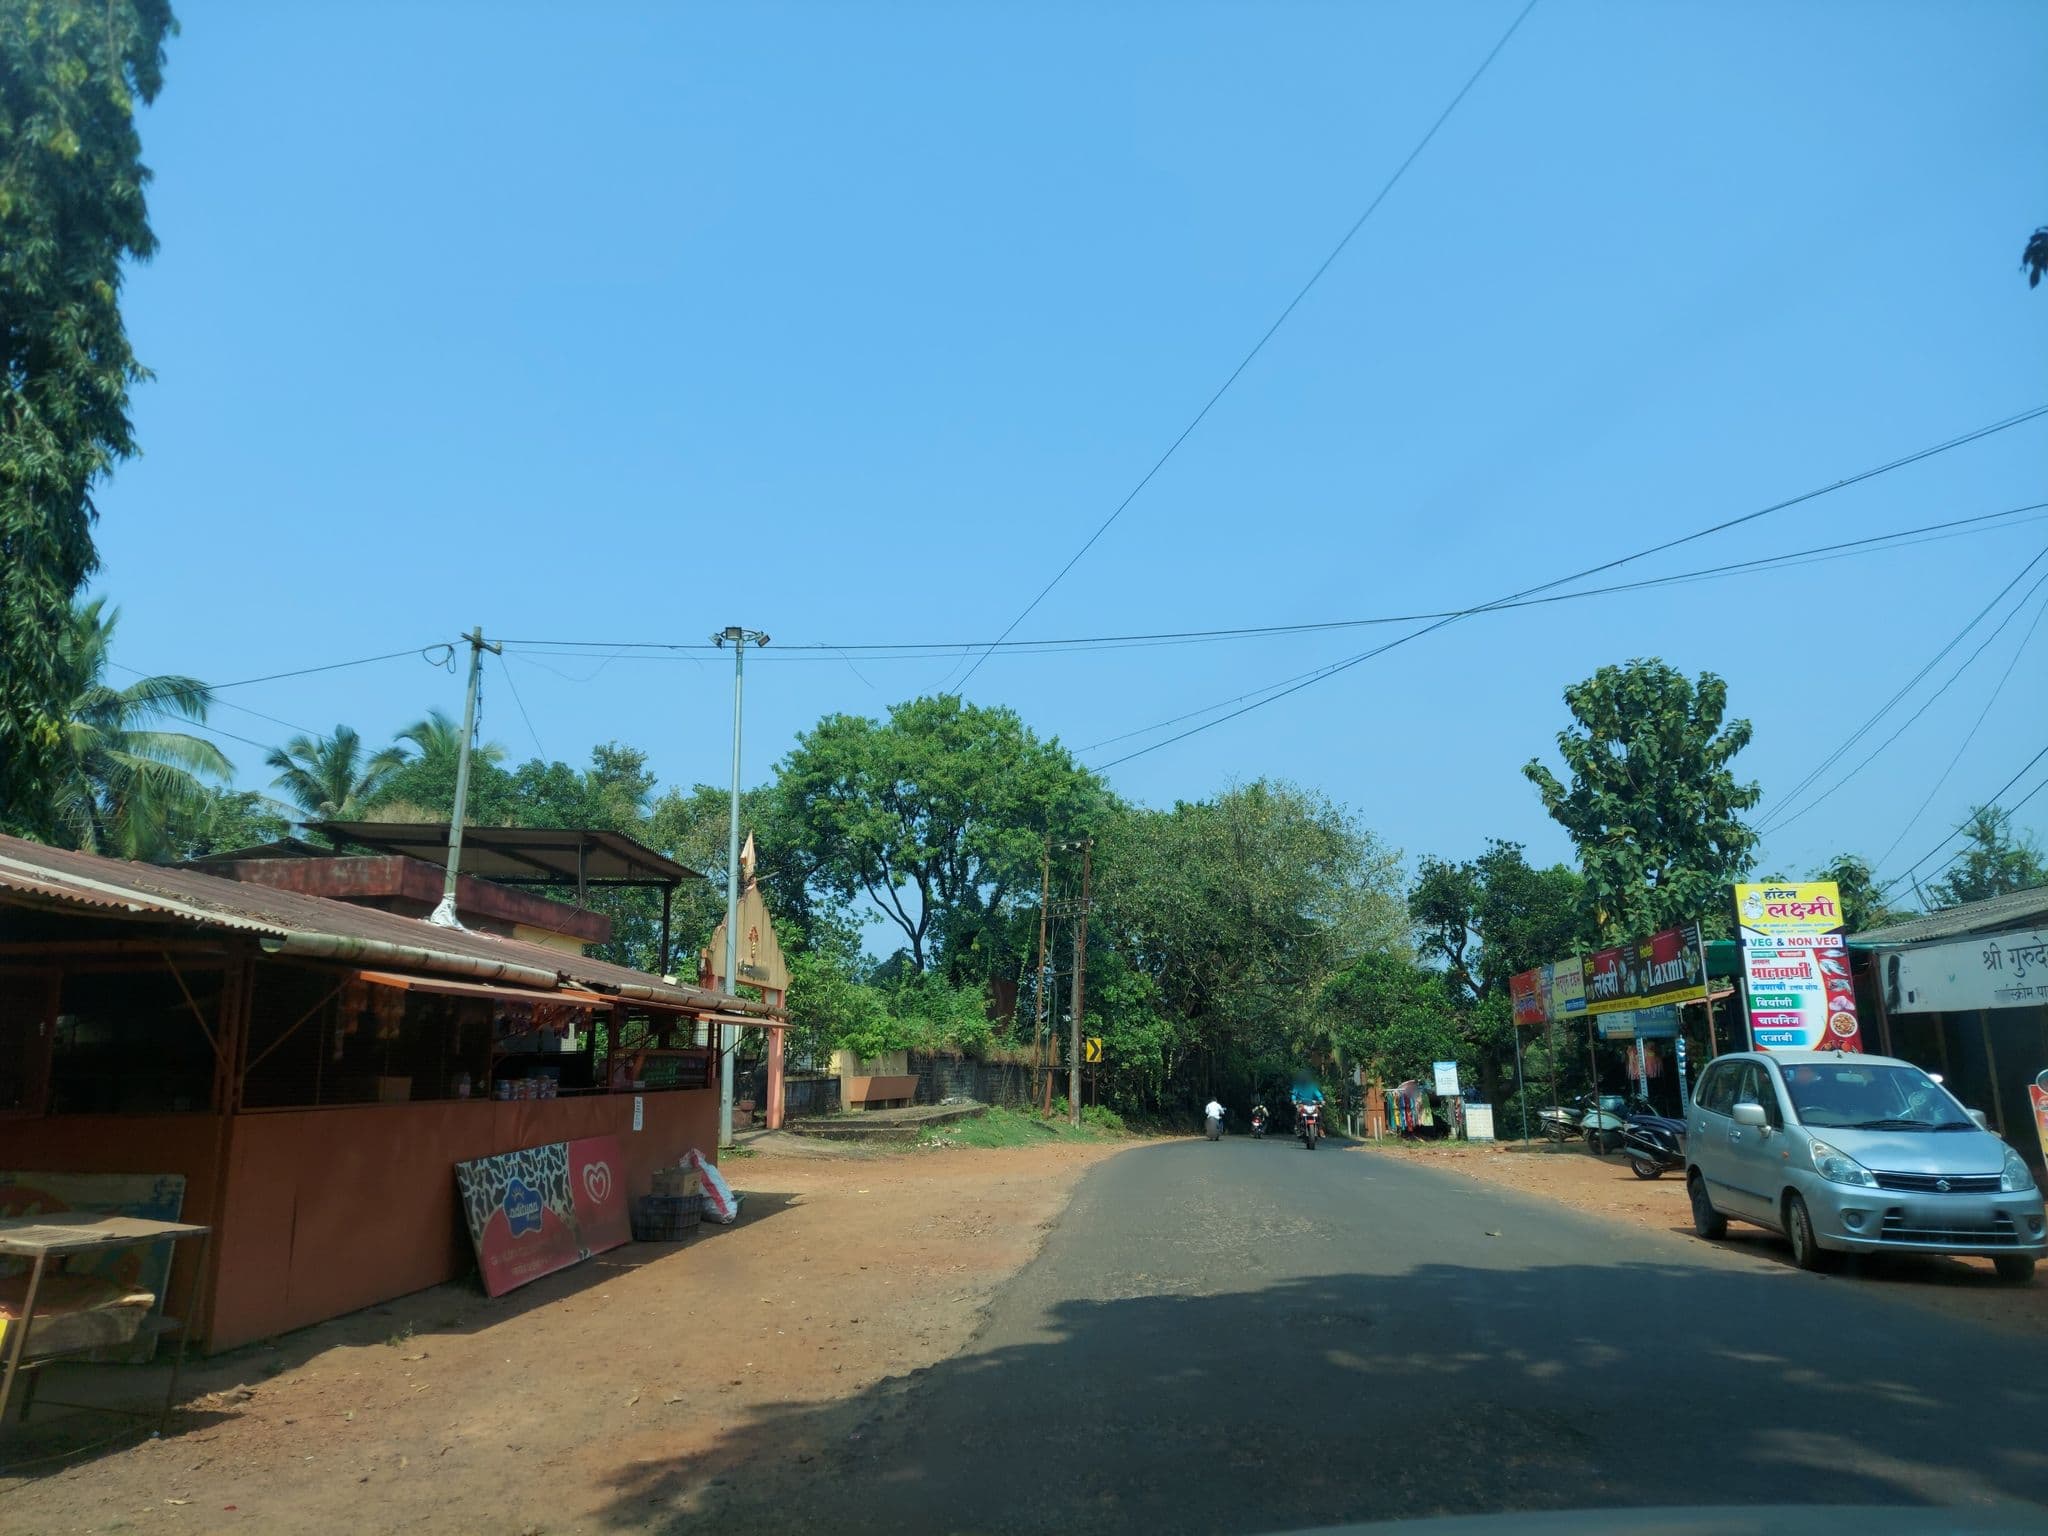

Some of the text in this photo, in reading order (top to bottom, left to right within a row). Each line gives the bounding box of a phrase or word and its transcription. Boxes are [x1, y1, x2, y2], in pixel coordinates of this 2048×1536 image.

[1763, 888, 1797, 900] हॉटेल
[1765, 896, 1834, 920] लक्ष्मी
[1750, 937, 1839, 946] VEG & NON VEG
[1646, 950, 1685, 986] Laxmi
[1983, 936, 2048, 977] श्री गुरुदे
